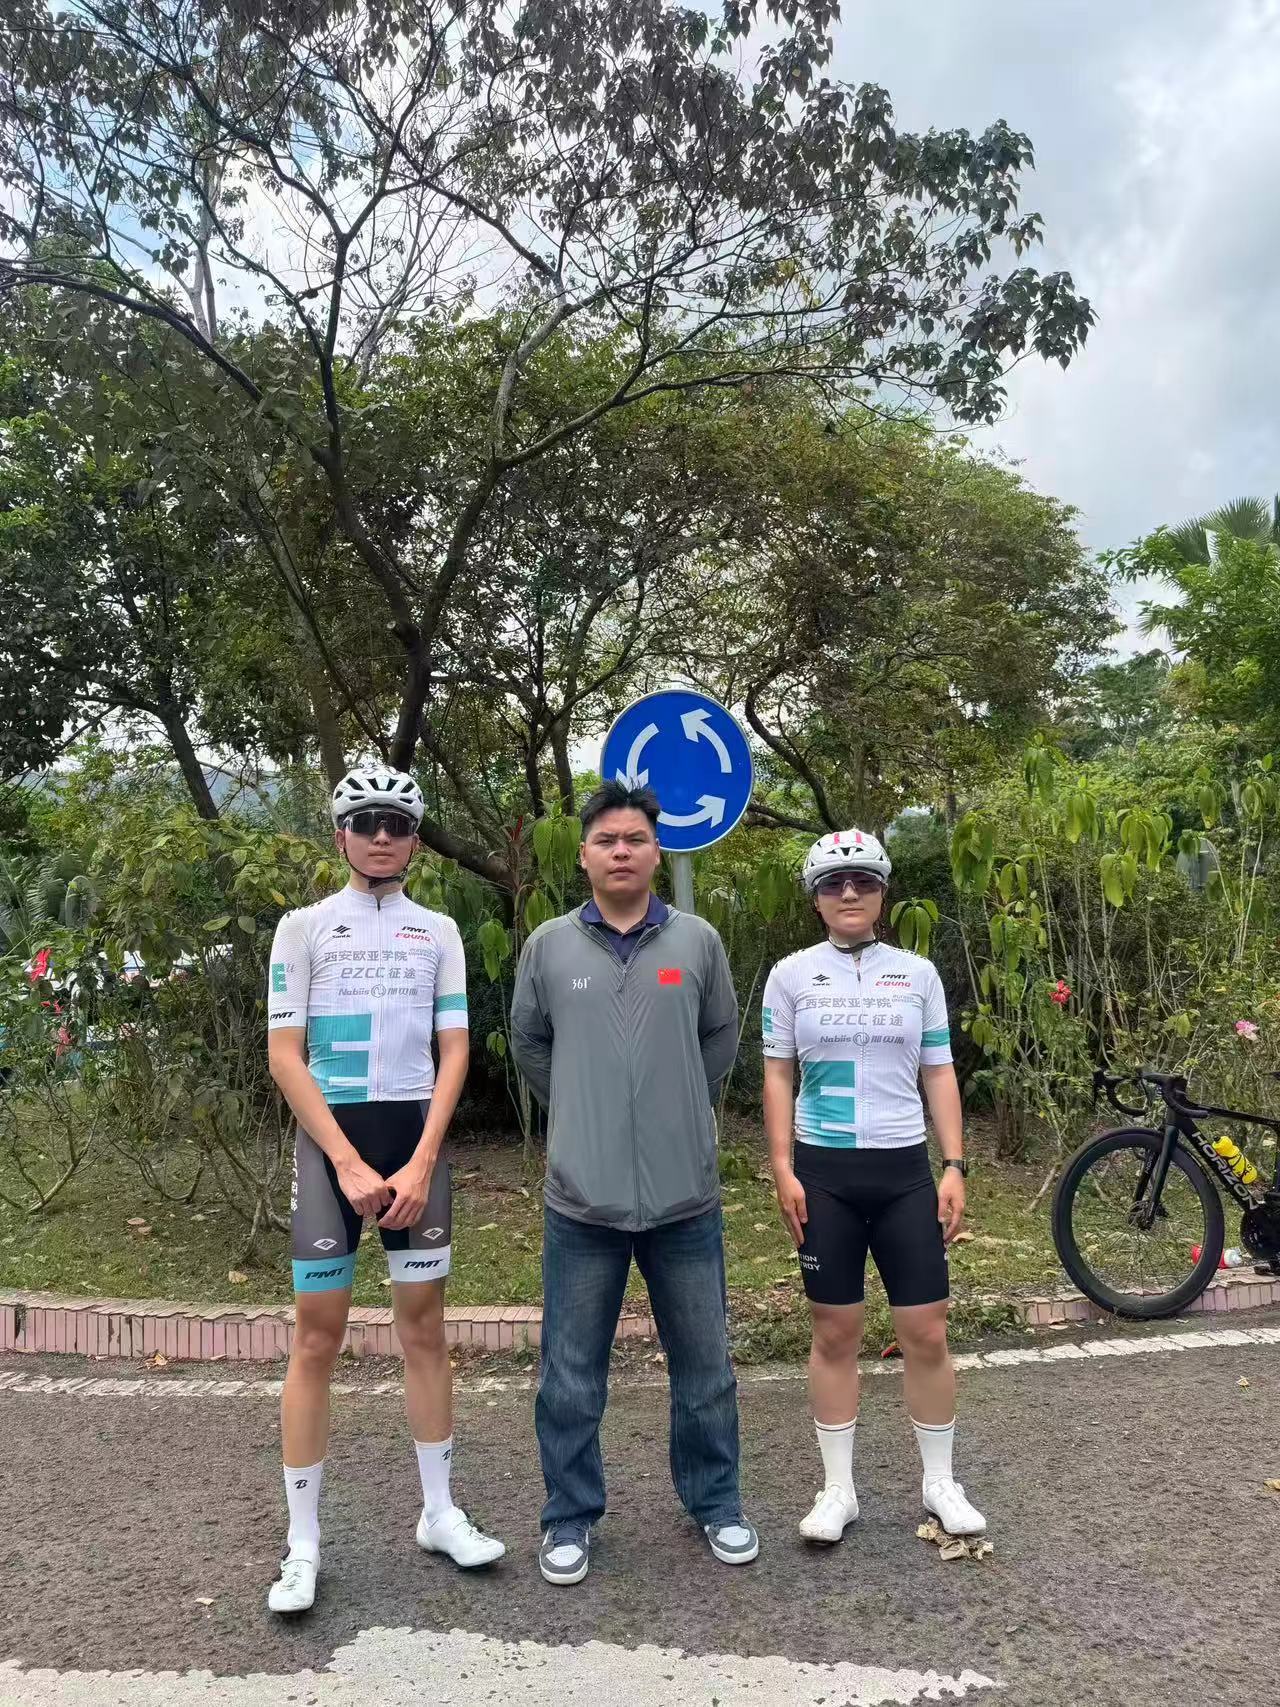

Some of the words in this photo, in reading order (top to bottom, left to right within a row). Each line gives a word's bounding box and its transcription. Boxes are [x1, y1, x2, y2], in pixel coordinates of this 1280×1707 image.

[324, 950, 408, 962] 西安欧亚学院
[388, 967, 416, 979] 征途
[806, 997, 892, 1008] 西安欧亚学院
[872, 1013, 904, 1026] 征途
[1191, 1131, 1260, 1210] HORIZON
[403, 1259, 443, 1269] PMT
[304, 1267, 346, 1279] PMT
